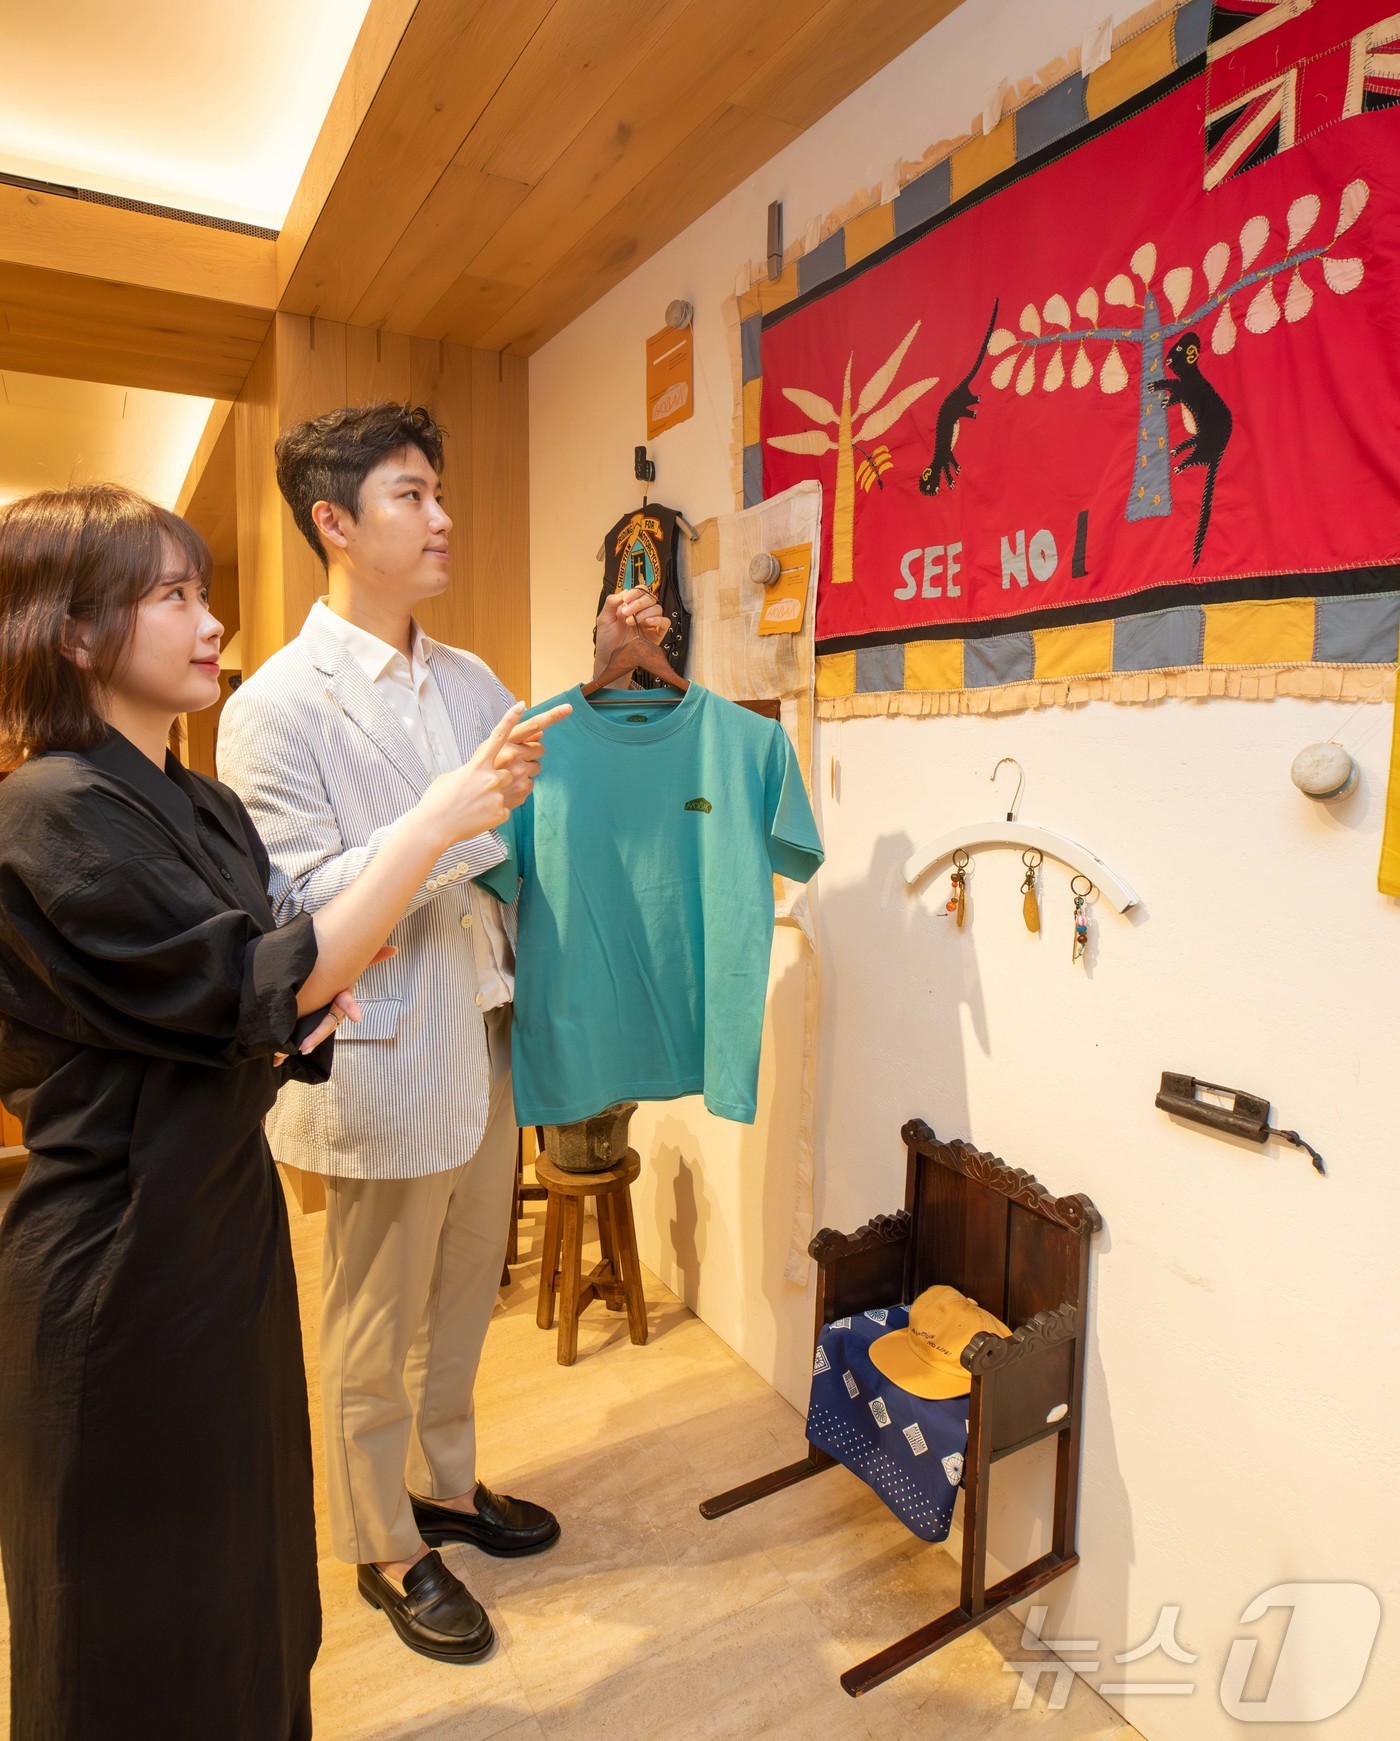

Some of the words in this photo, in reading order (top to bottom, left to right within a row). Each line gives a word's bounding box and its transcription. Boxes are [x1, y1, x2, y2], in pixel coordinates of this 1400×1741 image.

[645, 520, 655, 529] FOR
[617, 543, 632, 588] CHRISTIAN
[893, 541, 963, 600] SEE
[1001, 529, 1058, 590] NO
